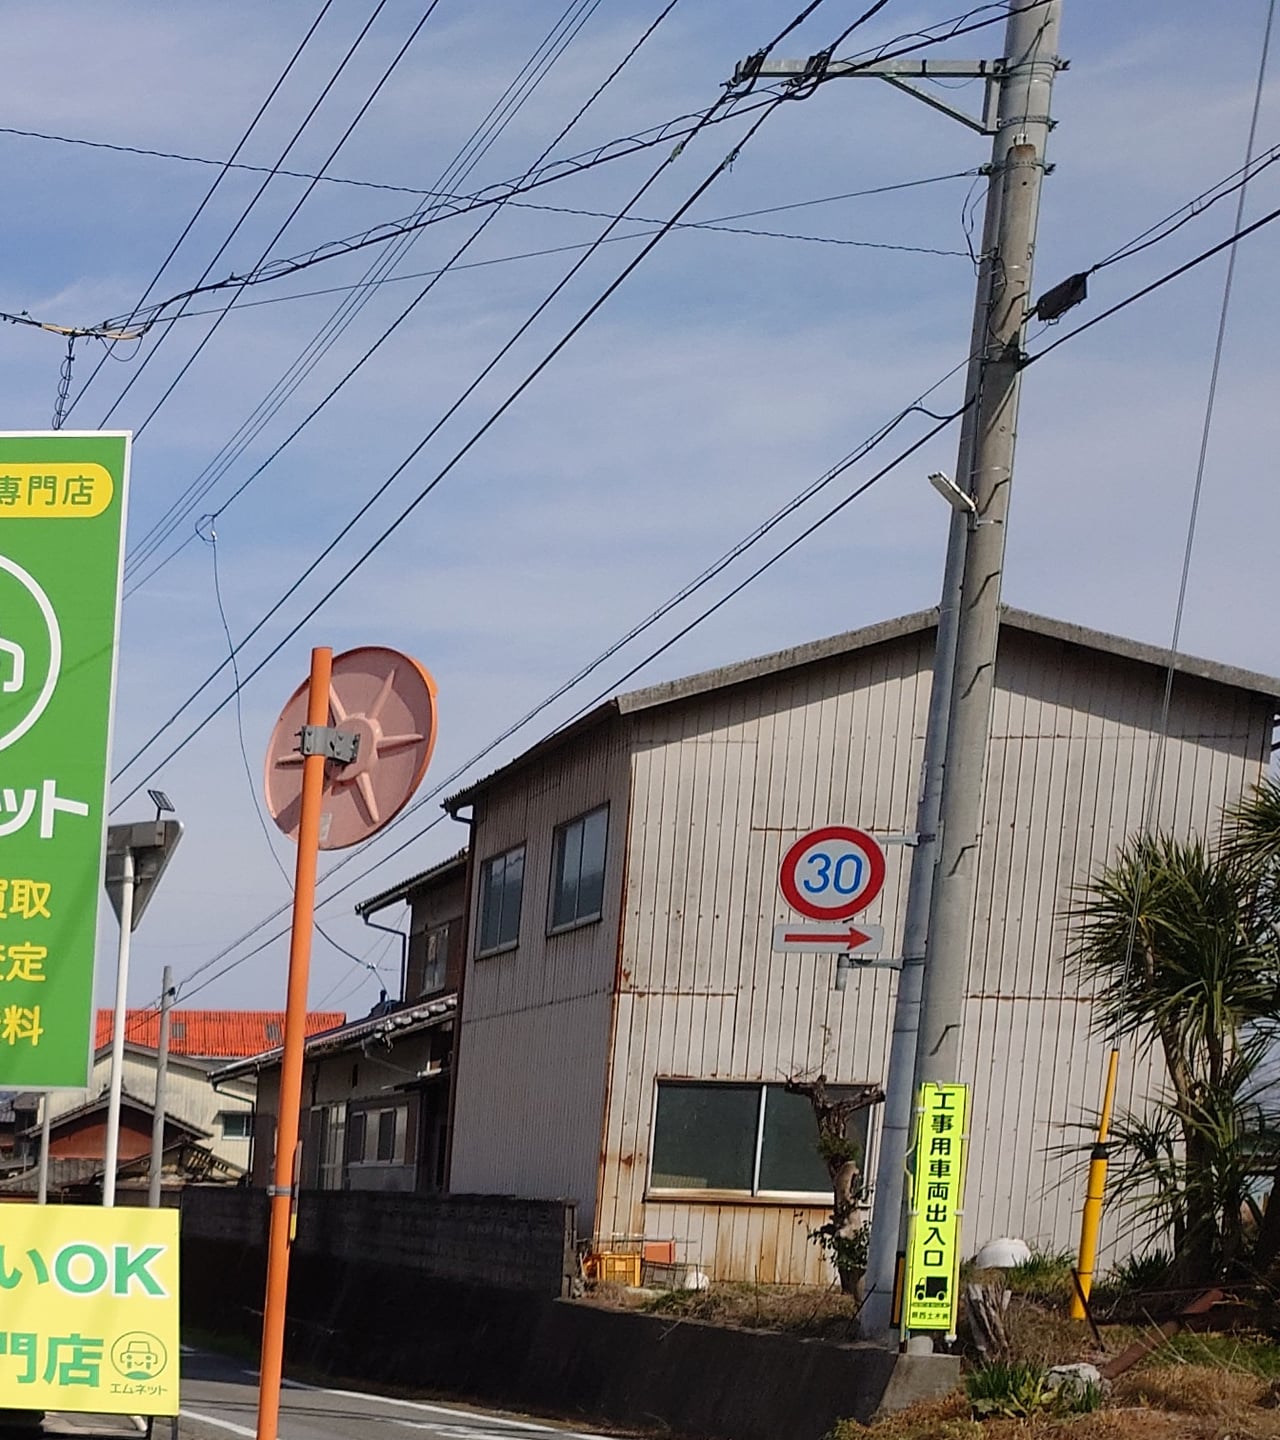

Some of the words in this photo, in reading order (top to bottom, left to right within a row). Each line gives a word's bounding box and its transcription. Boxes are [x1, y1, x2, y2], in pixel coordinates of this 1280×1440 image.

[803, 853, 863, 895] 30
[922, 1092, 956, 1267] 工事用車両出入口
[109, 1383, 169, 1397] エムネット
